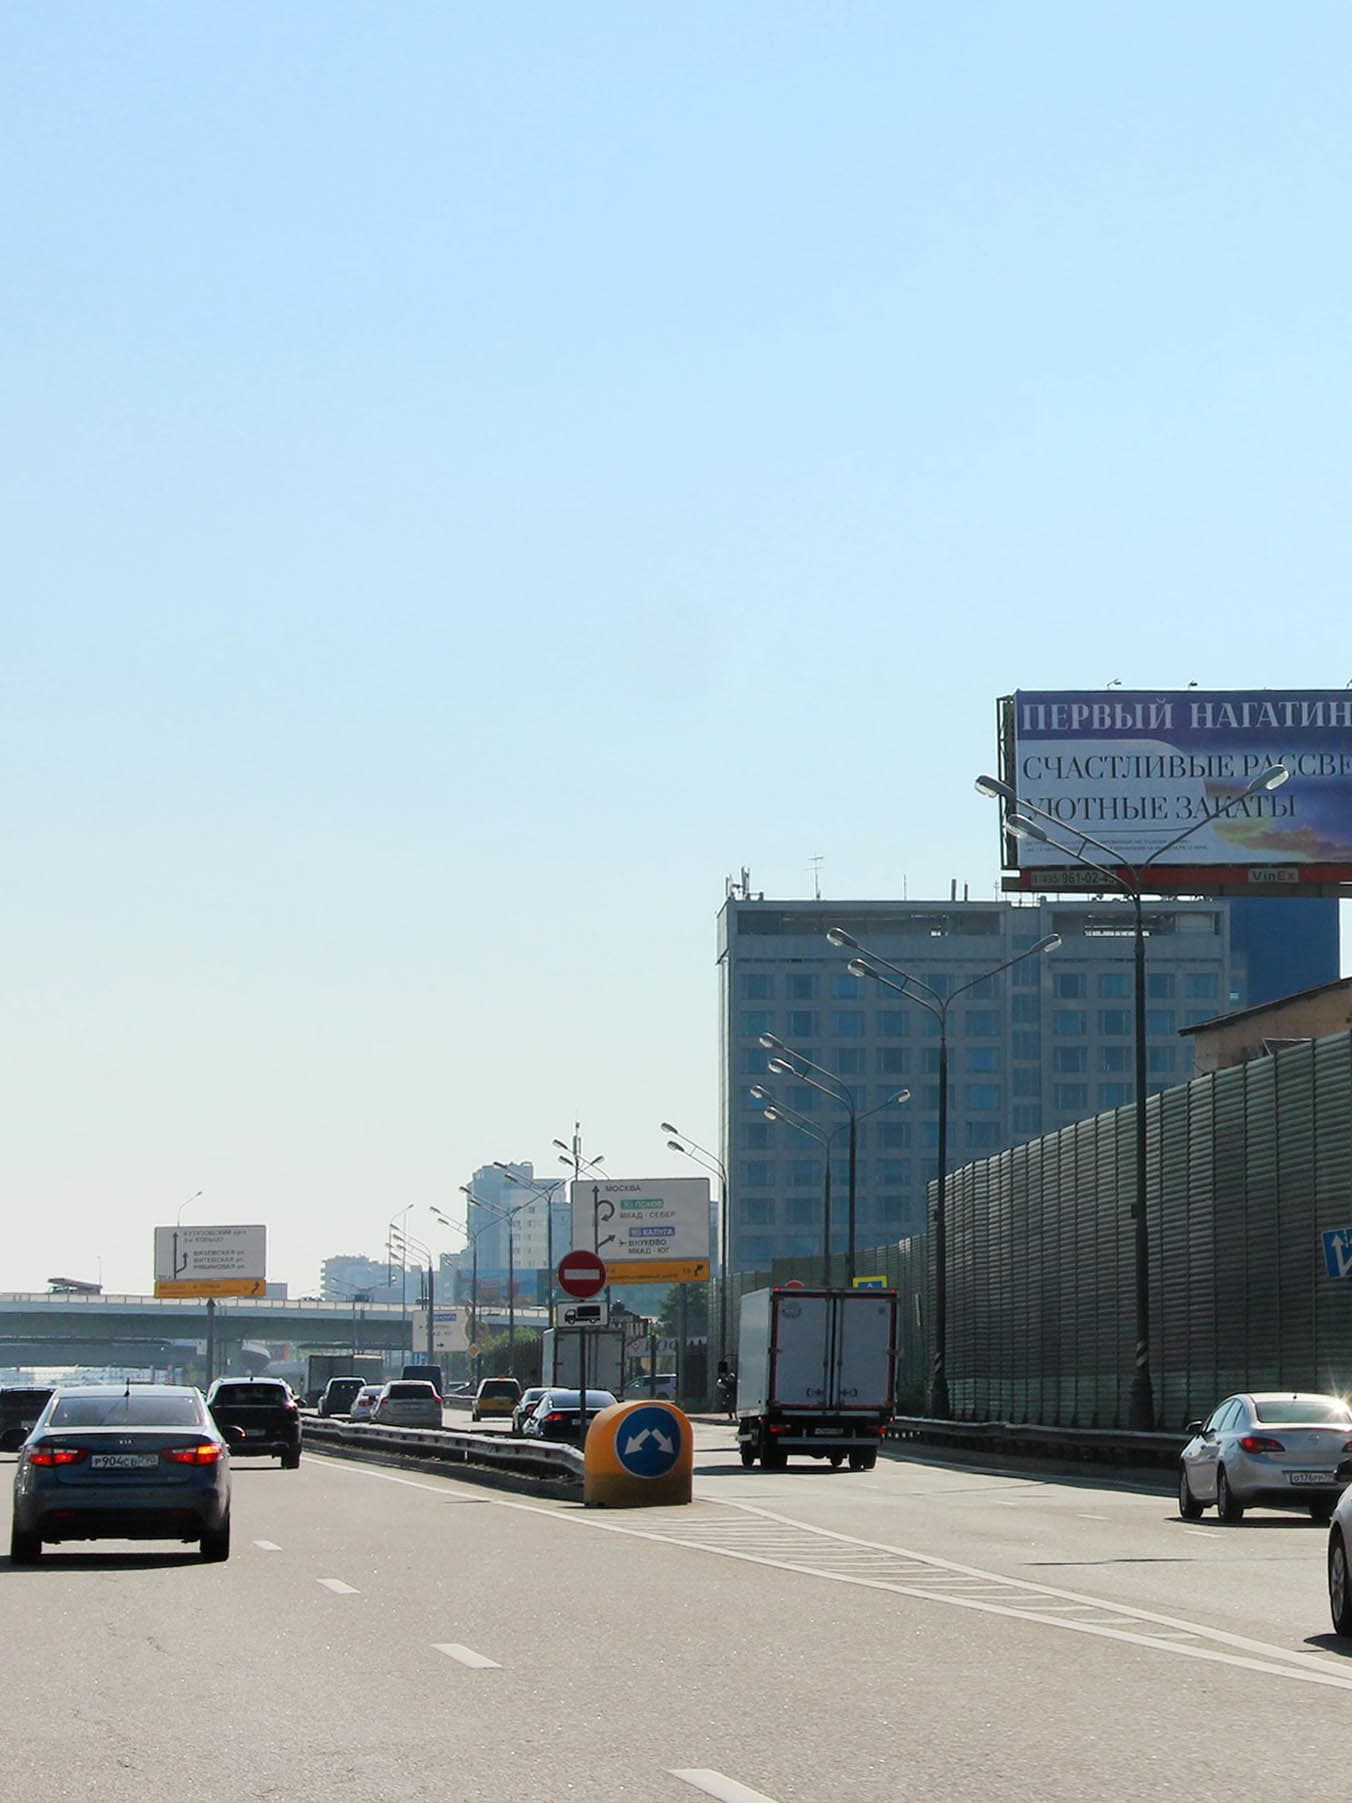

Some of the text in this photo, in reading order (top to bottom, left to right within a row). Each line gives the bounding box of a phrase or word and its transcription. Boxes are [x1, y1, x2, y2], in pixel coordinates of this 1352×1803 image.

[1022, 697, 1174, 731] ПЕРВЫЙ
[1022, 753, 1235, 780] СЧАСТЛИВЫЕ
[1175, 795, 1298, 820] ЗАКАТЫ
[1252, 870, 1297, 881] VinEx
[605, 1184, 641, 1192] МОСКВА
